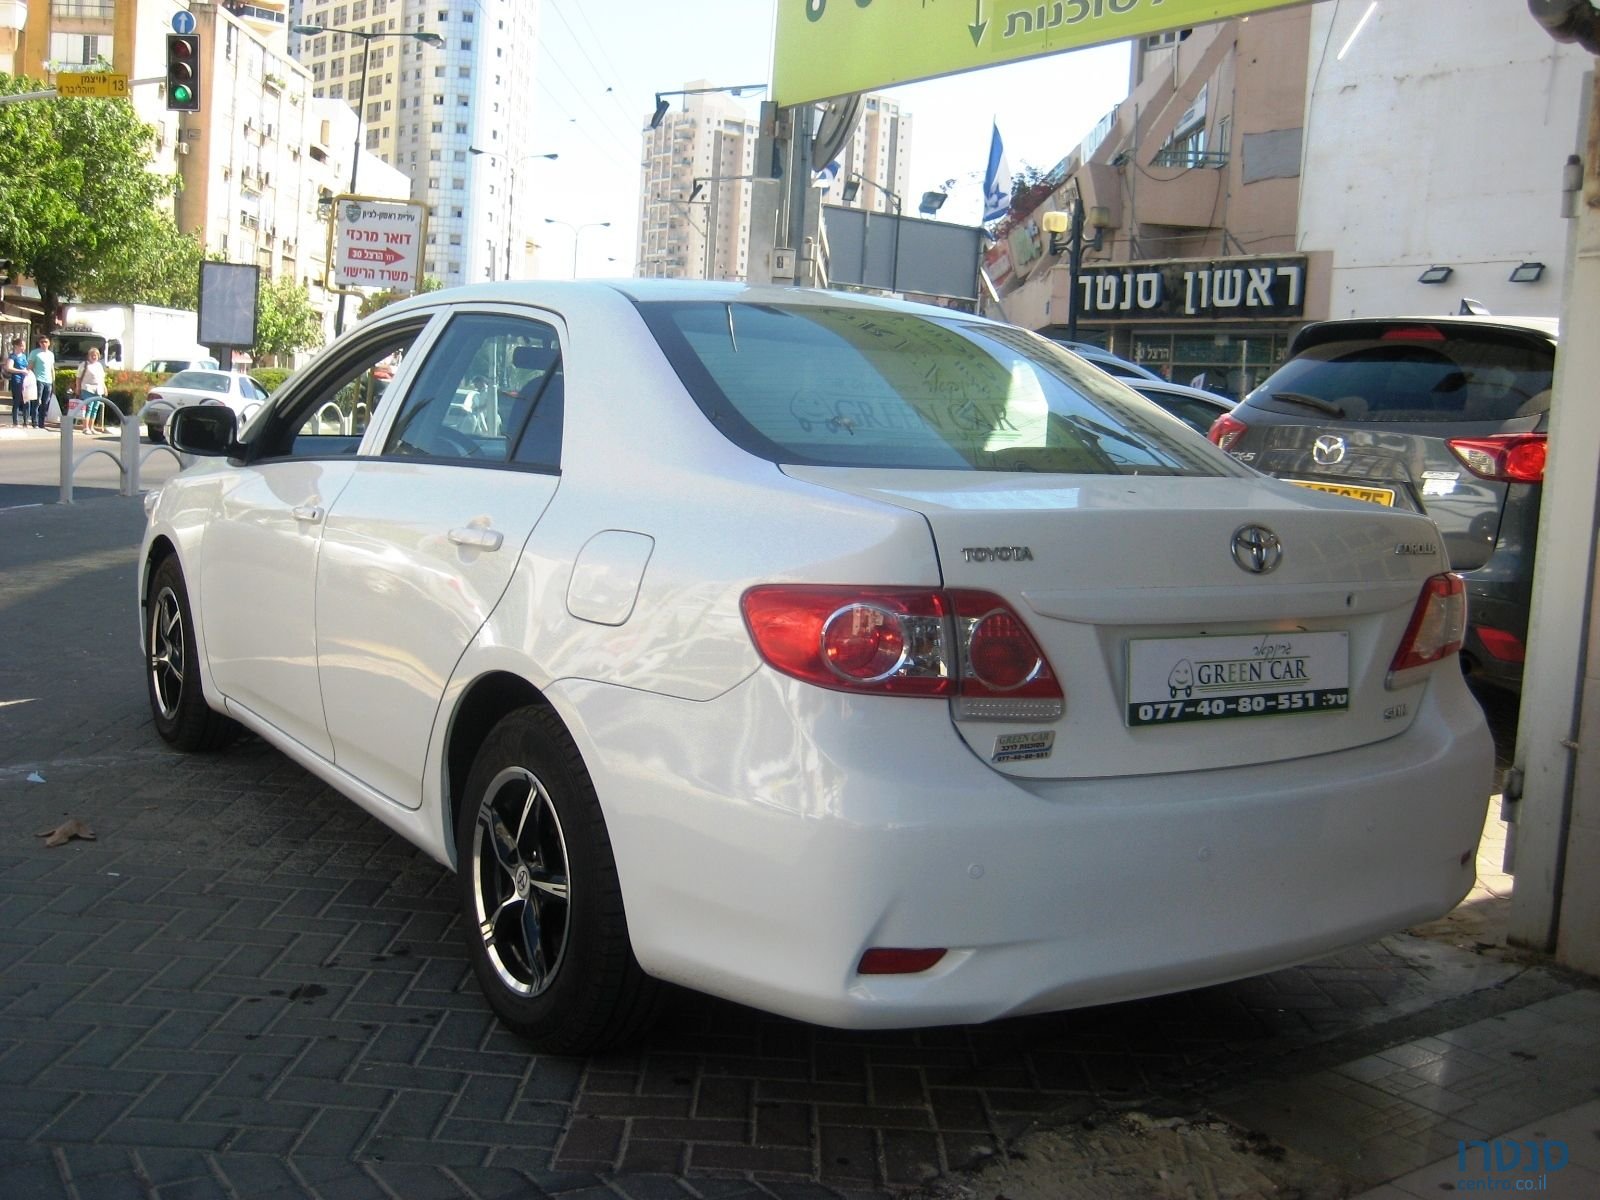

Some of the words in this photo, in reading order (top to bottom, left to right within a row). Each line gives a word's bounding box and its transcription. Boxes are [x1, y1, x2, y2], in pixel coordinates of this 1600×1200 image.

[81, 75, 101, 85] ויצמן
[112, 80, 124, 91] 13
[346, 229, 379, 242] מרכזי
[383, 232, 412, 245] דואר
[352, 250, 362, 258] 30
[364, 250, 383, 261] הרצל
[343, 266, 375, 279] הרישוי
[379, 269, 409, 282] משרד
[1078, 273, 1161, 310] סנטר
[1184, 266, 1301, 314] ראשון
[835, 400, 943, 430] GREEN
[947, 399, 1020, 432] CAR
[961, 546, 1034, 562] TOYOTA
[1198, 662, 1262, 685] GREEN
[1271, 659, 1308, 680] CAR
[1322, 693, 1348, 706] טל:
[1138, 692, 1315, 721] 077-40-80-551
